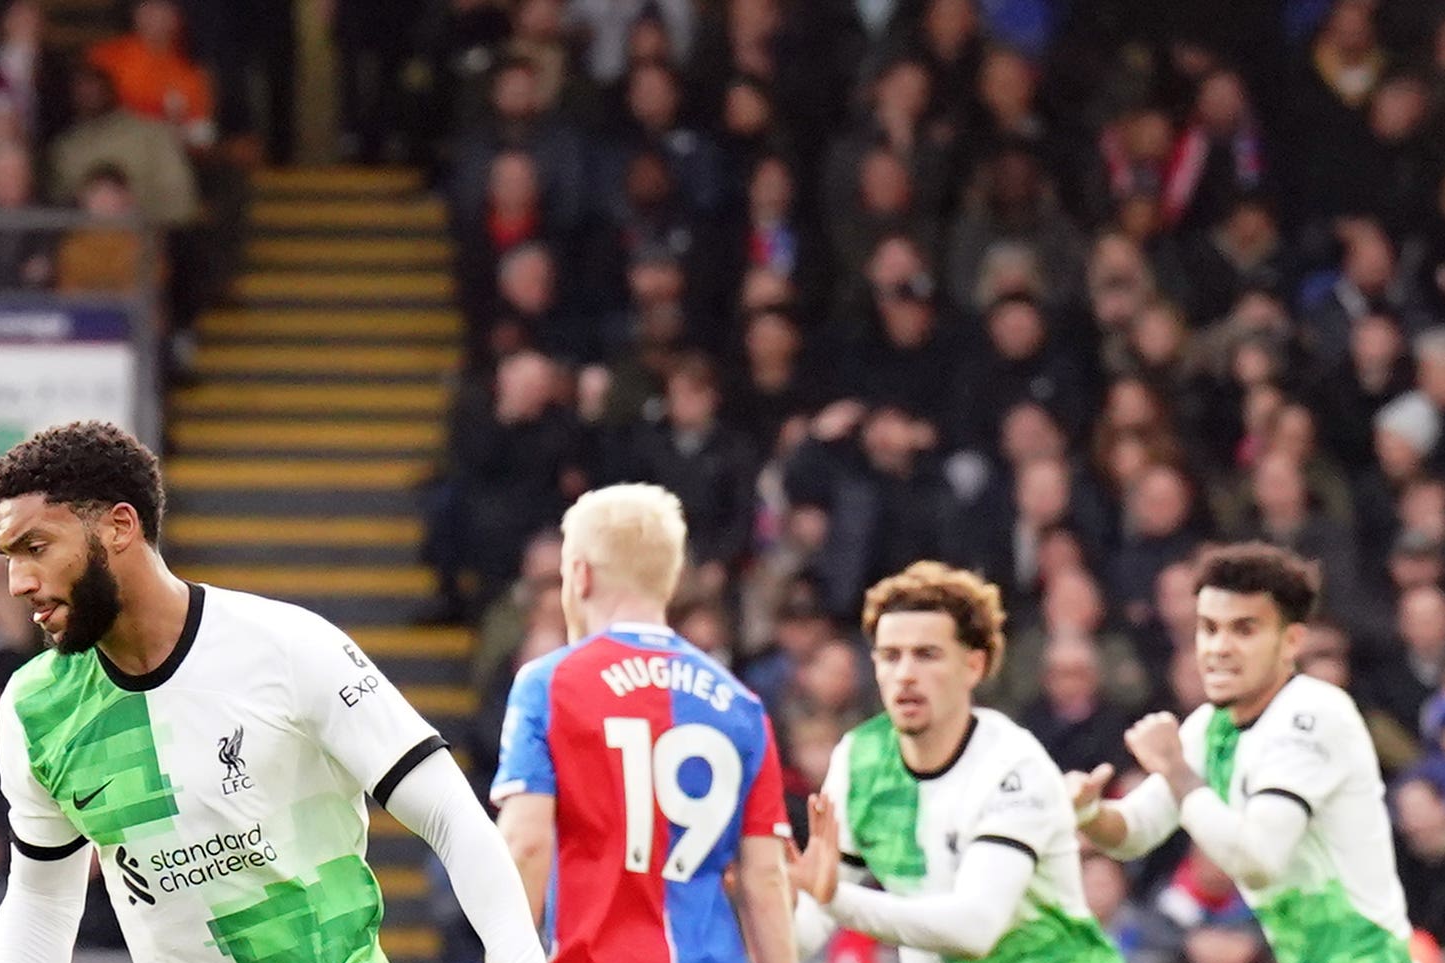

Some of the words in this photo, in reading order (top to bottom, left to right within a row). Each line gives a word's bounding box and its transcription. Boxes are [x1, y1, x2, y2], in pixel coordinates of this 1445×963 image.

[600, 656, 734, 712] HUGHES
[603, 716, 744, 884] 19
[151, 823, 262, 873] standard
[159, 843, 278, 893] chartered
